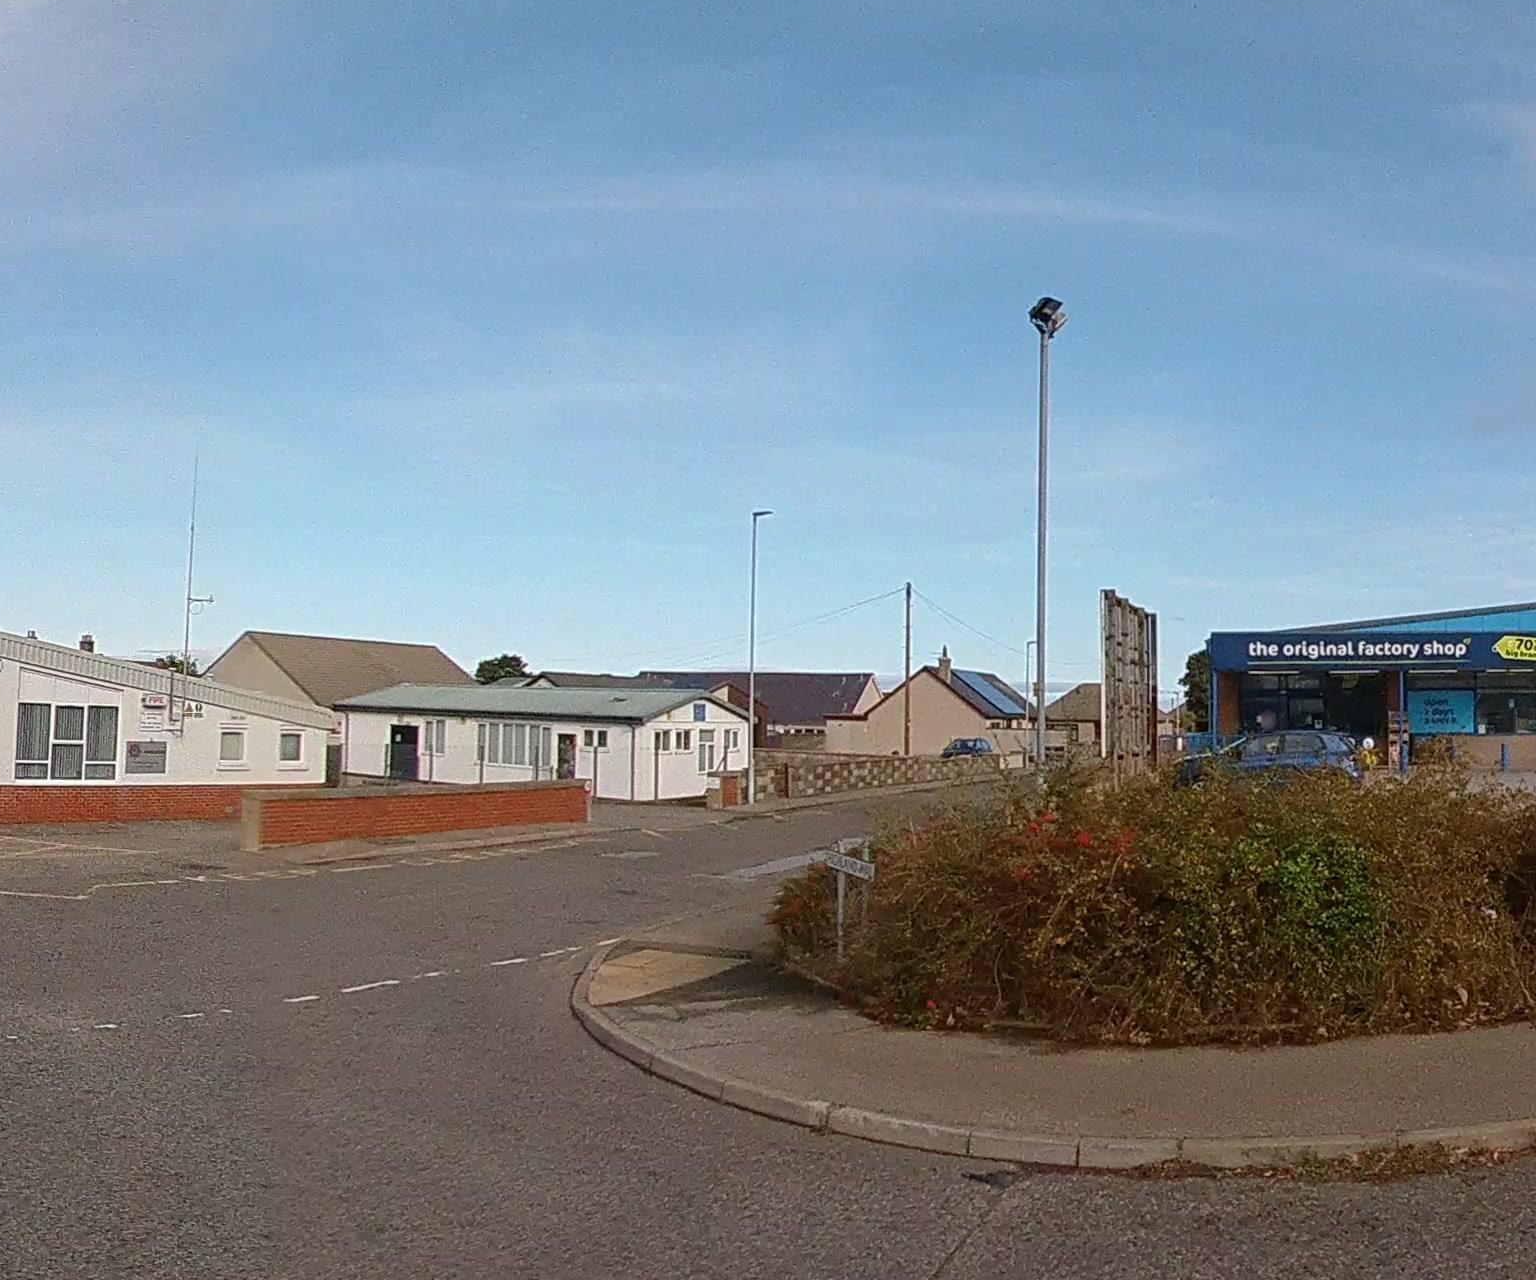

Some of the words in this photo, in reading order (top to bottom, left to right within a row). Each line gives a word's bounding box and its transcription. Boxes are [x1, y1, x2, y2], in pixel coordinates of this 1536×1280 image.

[1248, 641, 1279, 657] the
[1283, 641, 1354, 659] original
[1358, 641, 1420, 659] factory
[1423, 641, 1467, 658] shop
